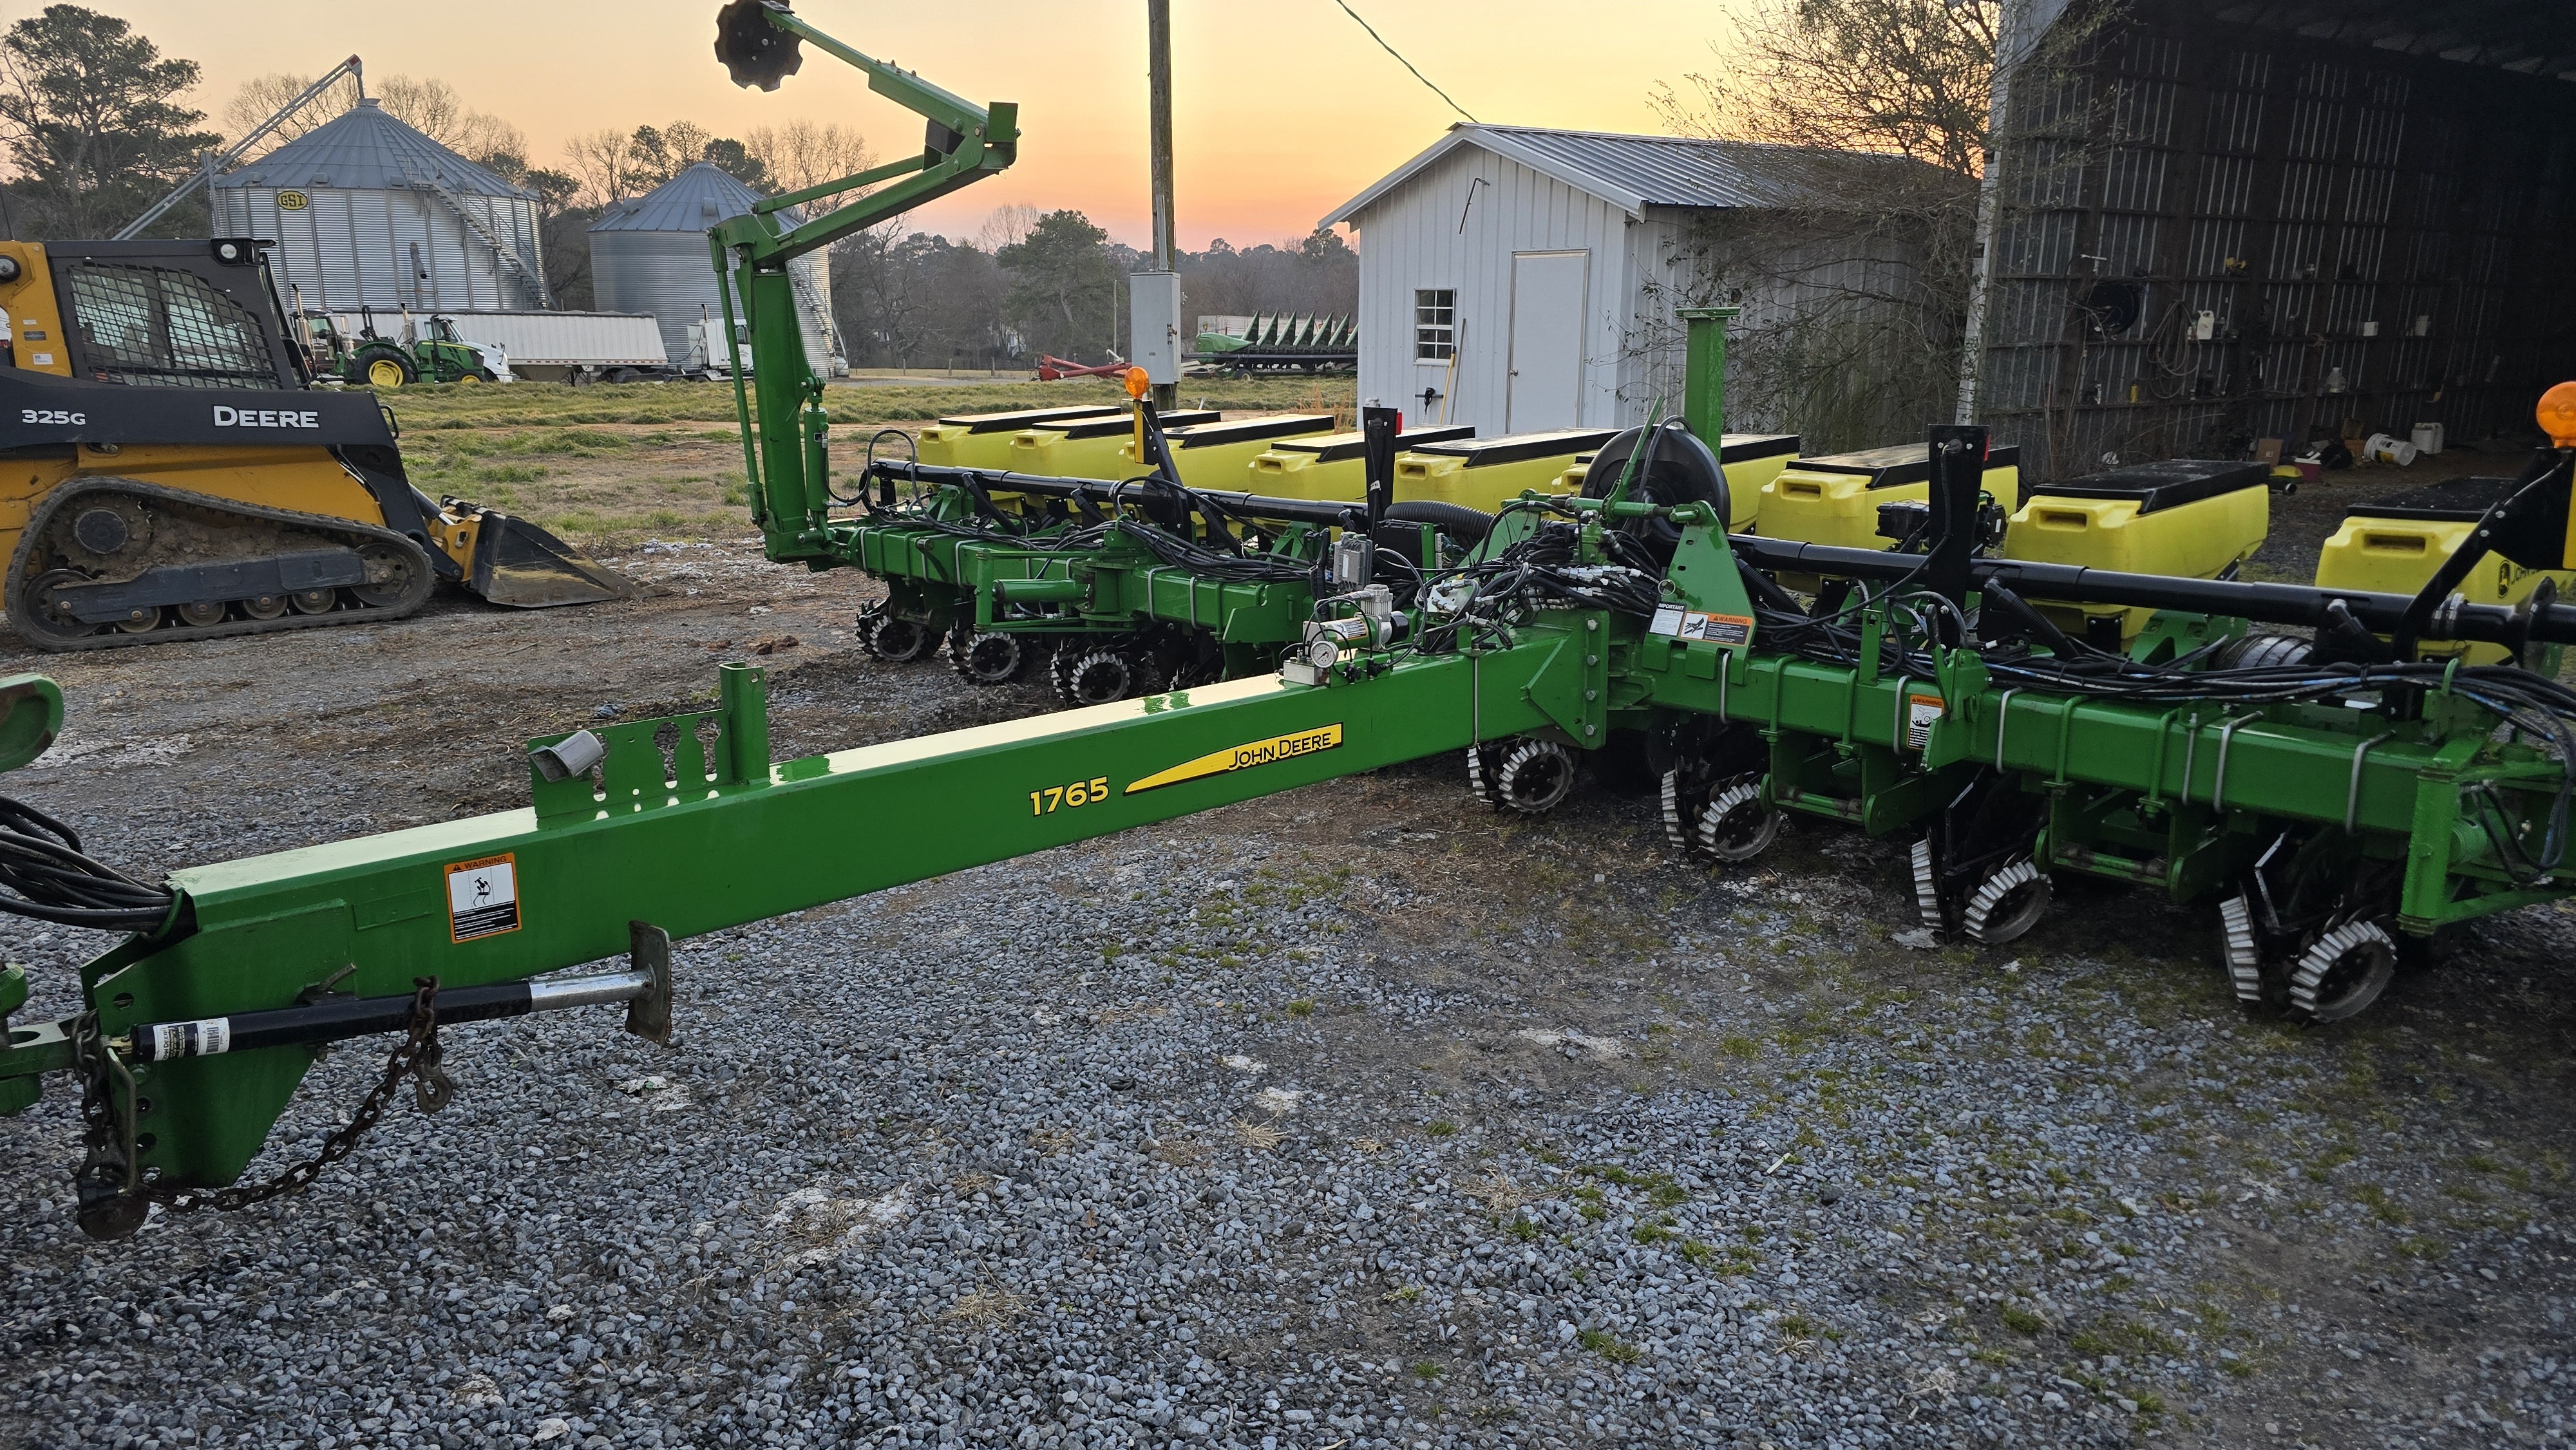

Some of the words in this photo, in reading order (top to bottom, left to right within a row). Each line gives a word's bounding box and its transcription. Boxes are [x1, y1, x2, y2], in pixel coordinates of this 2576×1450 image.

[281, 194, 304, 207] GSI
[22, 410, 86, 425] 325G
[213, 406, 319, 428] DEERE
[1719, 616, 1747, 624] WARNING
[1917, 698, 1942, 706] WARNING
[1229, 745, 1274, 768] JOHN
[1279, 732, 1331, 757] DEERE
[1030, 775, 1109, 816] 1765
[464, 855, 507, 869] WARNING
